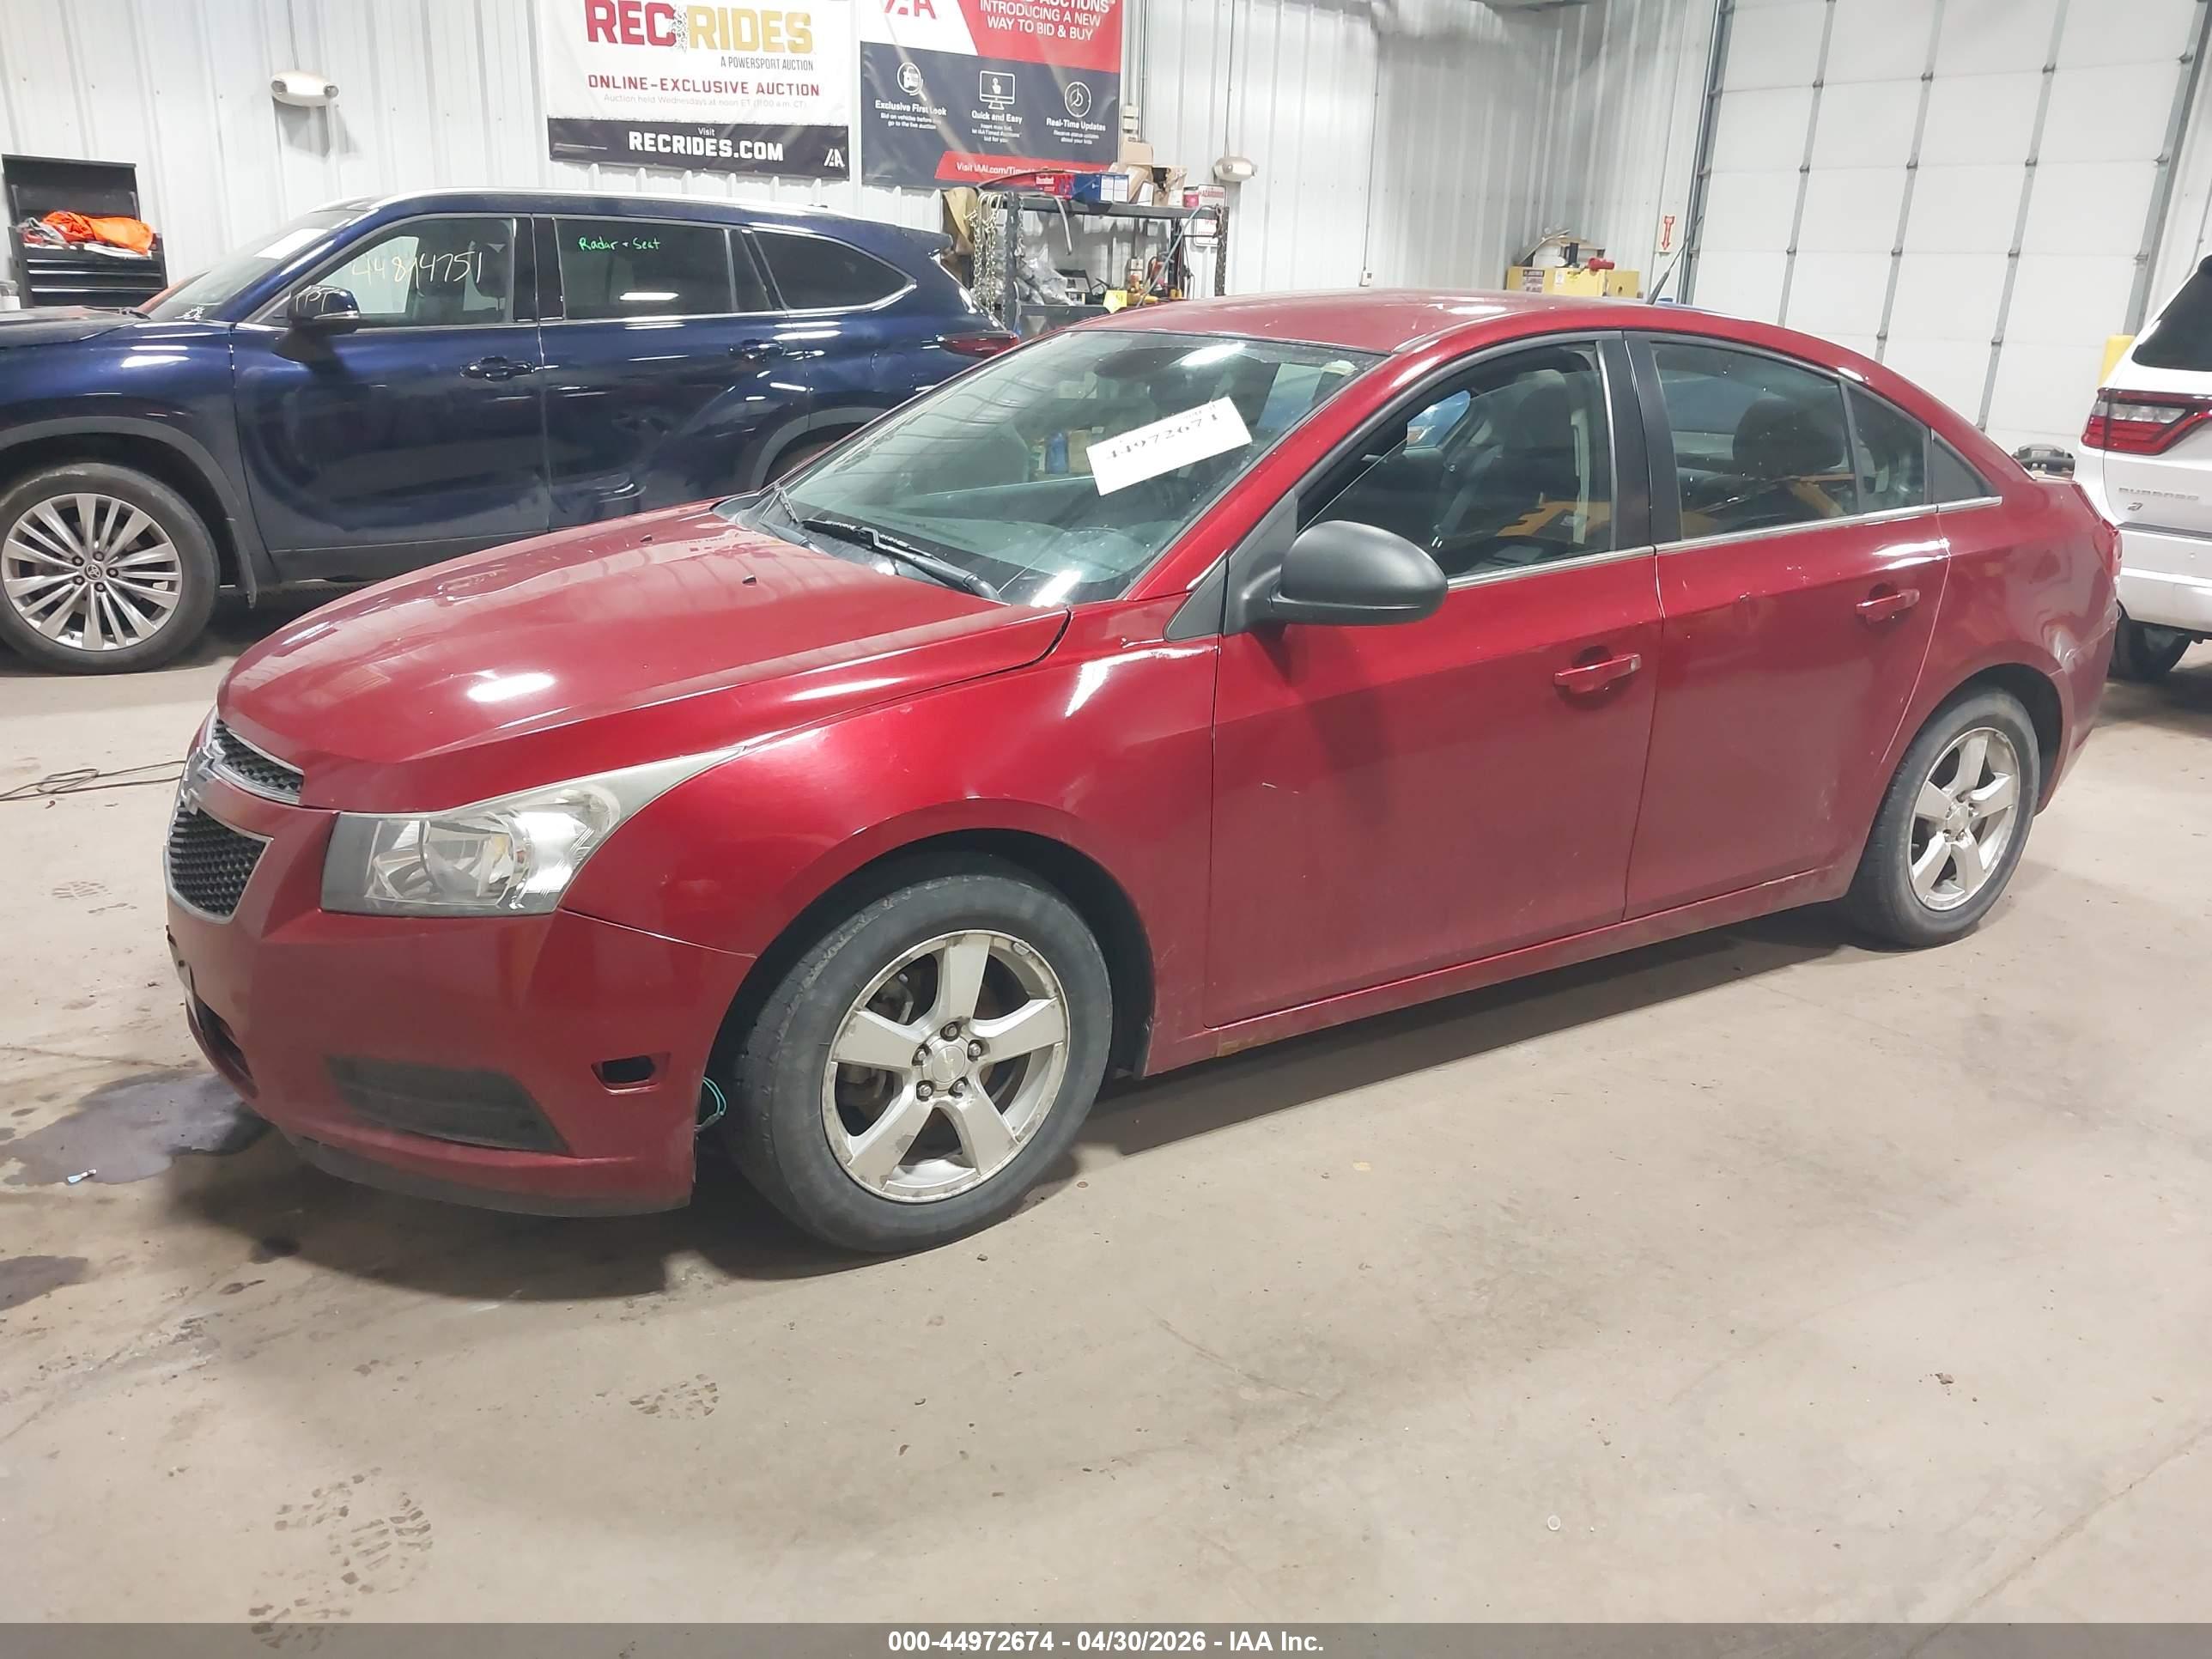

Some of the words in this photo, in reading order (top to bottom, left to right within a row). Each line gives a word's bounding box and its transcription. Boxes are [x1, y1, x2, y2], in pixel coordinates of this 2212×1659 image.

[981, 0, 1060, 21] INTRODUCING
[1063, 11, 1072, 23] A
[1074, 13, 1101, 27] NEW
[988, 15, 1015, 30] WAY
[1018, 19, 1034, 33] TO
[1036, 22, 1054, 36] BID
[1057, 25, 1066, 38] &
[1070, 27, 1093, 40] BUY
[720, 56, 726, 68] A
[728, 57, 780, 70] POWERSPORT
[782, 59, 813, 70] AUCTION
[588, 74, 749, 94] ONLINE-EXCLUSIVE
[756, 82, 820, 96] AUCTION
[604, 94, 635, 103] Auction
[637, 95, 656, 104] held
[875, 100, 910, 112] Exclusive
[912, 103, 928, 113] First
[930, 106, 947, 116] Look
[971, 110, 990, 120] Quick
[992, 113, 1005, 122] and
[1006, 113, 1023, 125] Easy
[1047, 117, 1079, 129] Real-Time
[1081, 121, 1106, 131] Updates
[698, 127, 714, 137] Visit
[629, 131, 784, 161] RECRIDES.COM
[957, 161, 973, 173] Visit
[579, 236, 618, 251] Radar
[632, 237, 660, 250] Seat
